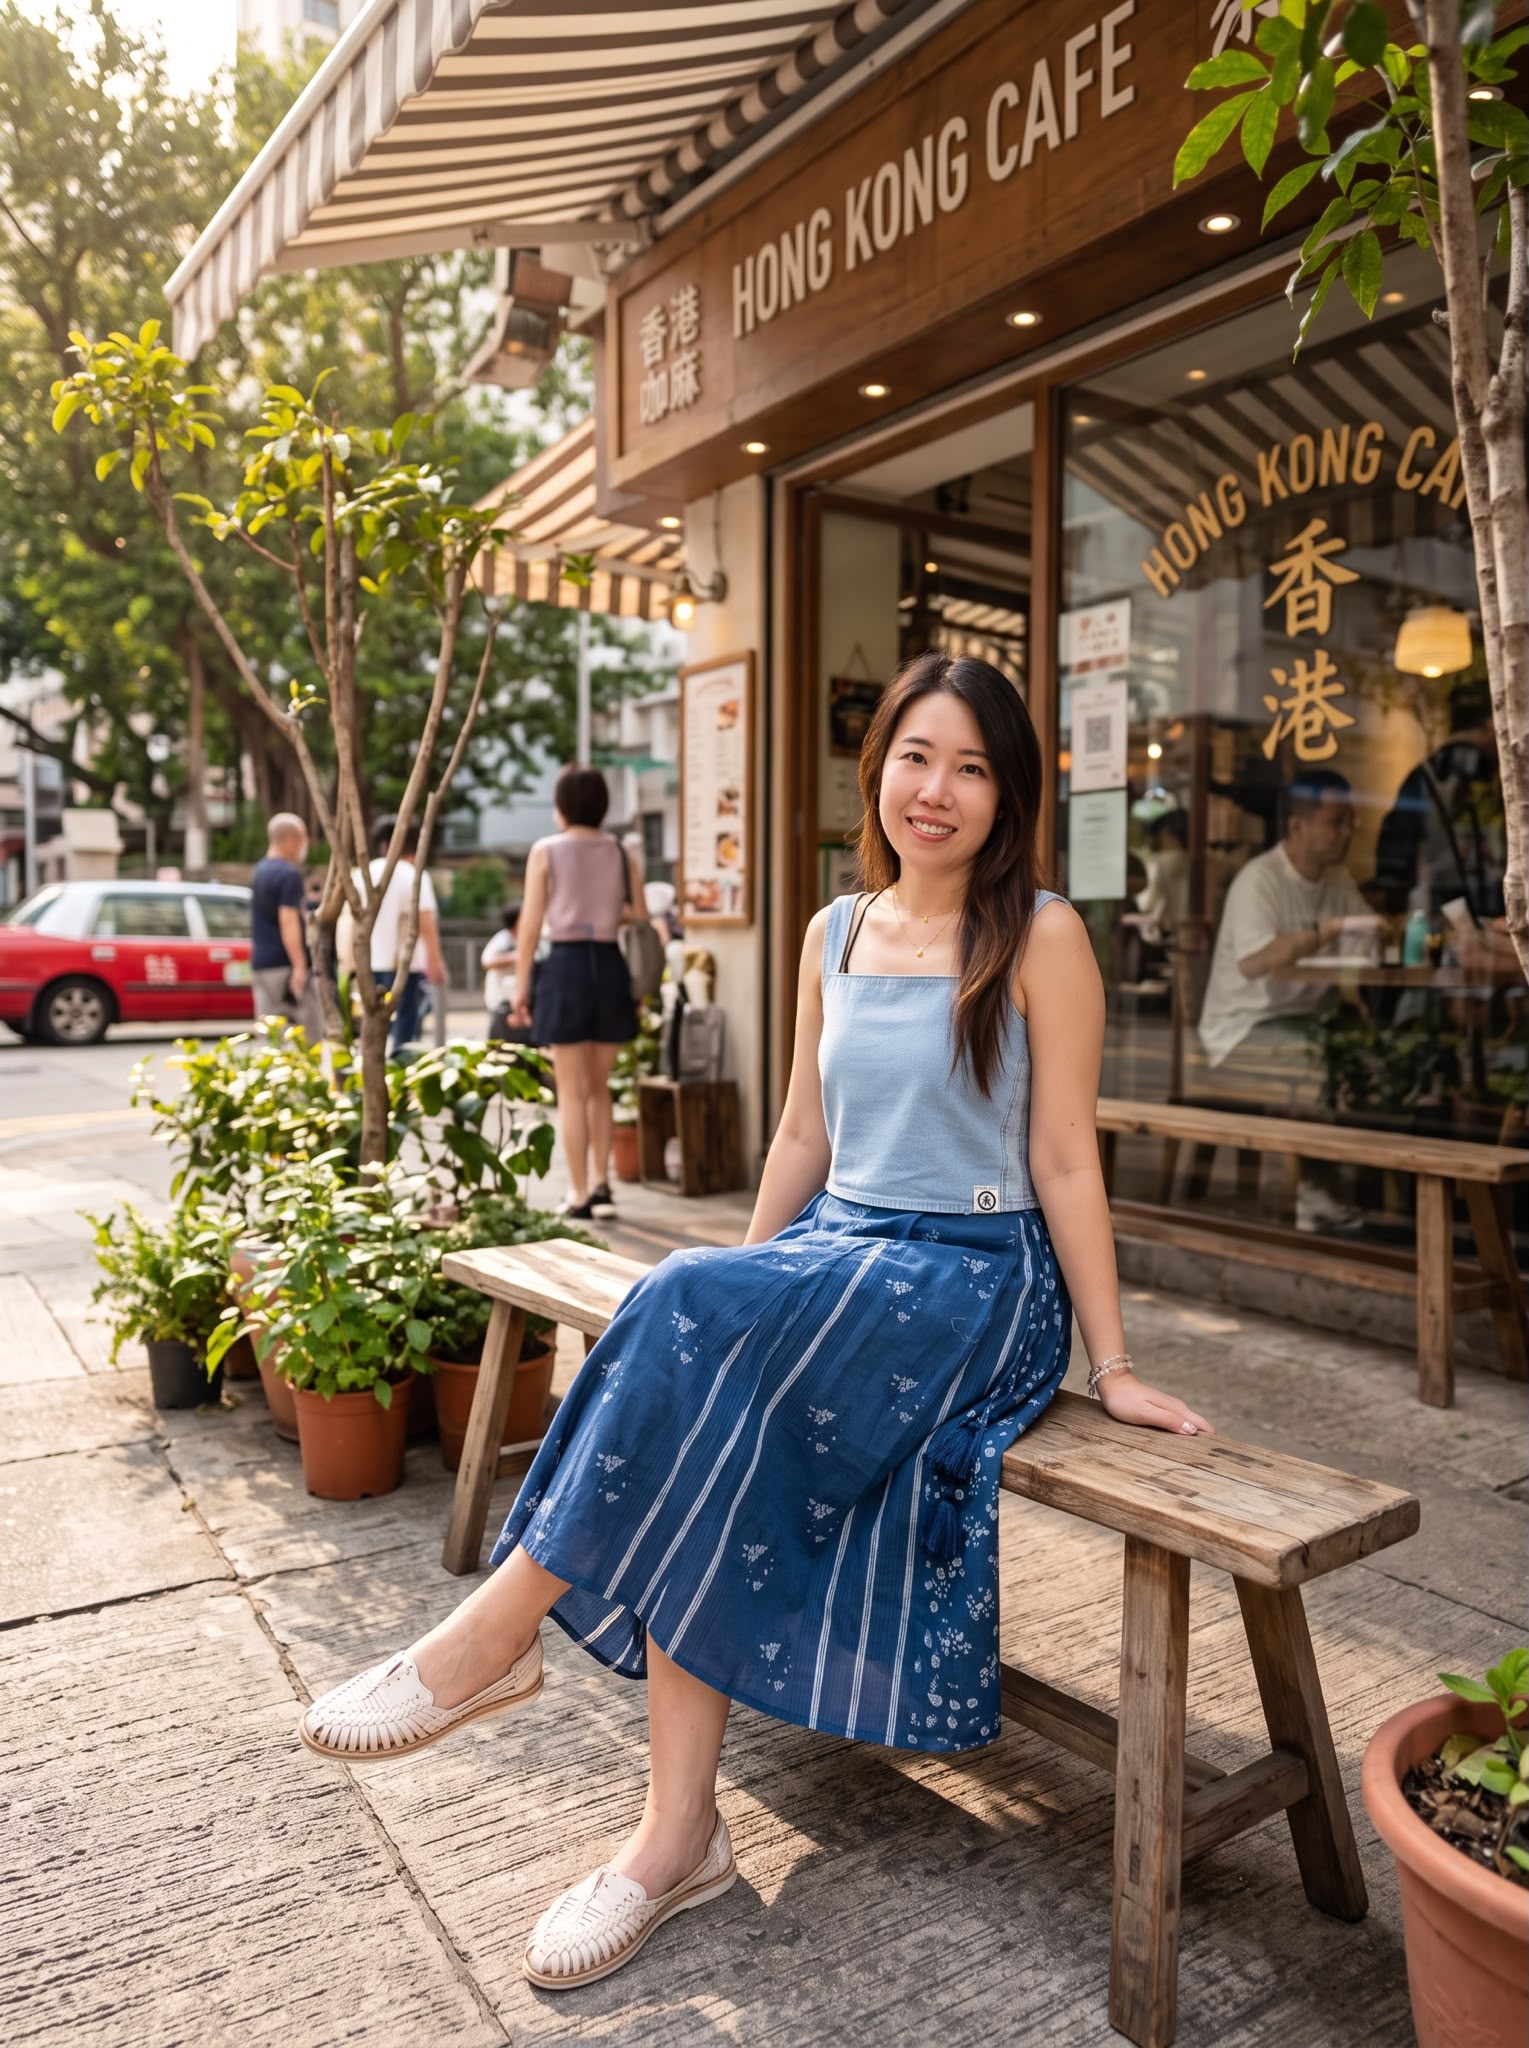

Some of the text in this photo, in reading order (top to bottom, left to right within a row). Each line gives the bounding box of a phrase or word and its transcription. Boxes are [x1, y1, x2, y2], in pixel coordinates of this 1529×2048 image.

[732, 0, 1135, 339] HONG KONG CAFE
[640, 284, 699, 369] 香港
[1141, 421, 1468, 598] HONG KONG CA
[1262, 517, 1361, 762] 香港
